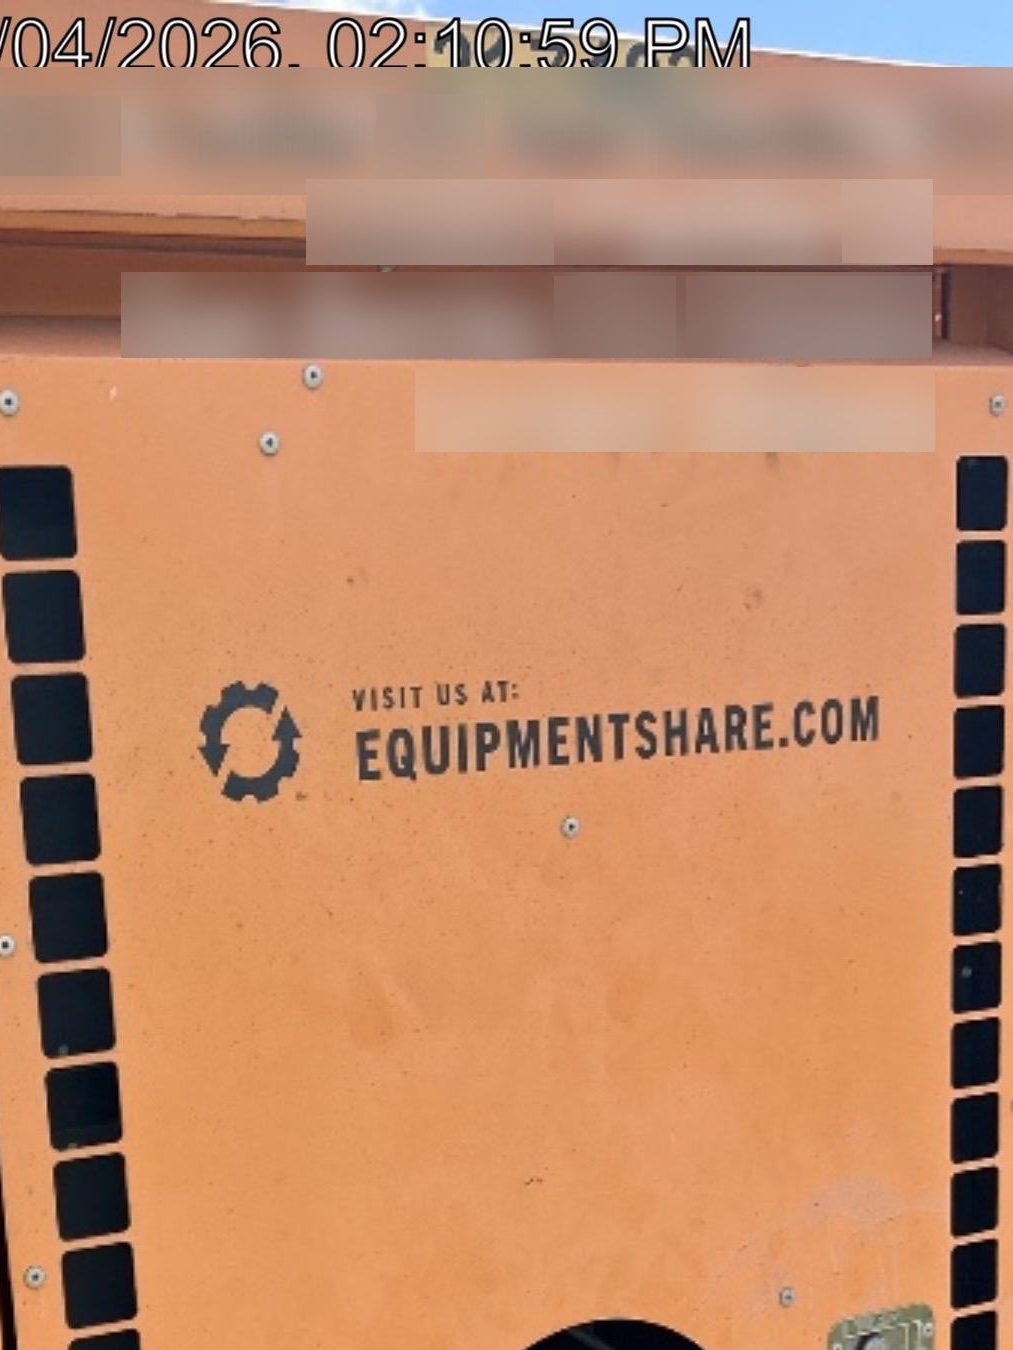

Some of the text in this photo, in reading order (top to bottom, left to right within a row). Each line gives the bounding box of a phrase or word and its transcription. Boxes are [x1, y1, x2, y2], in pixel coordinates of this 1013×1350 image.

[352, 680, 519, 711] VISIT US AT:
[355, 696, 880, 781] EQUIPMENTSHARE.COM
